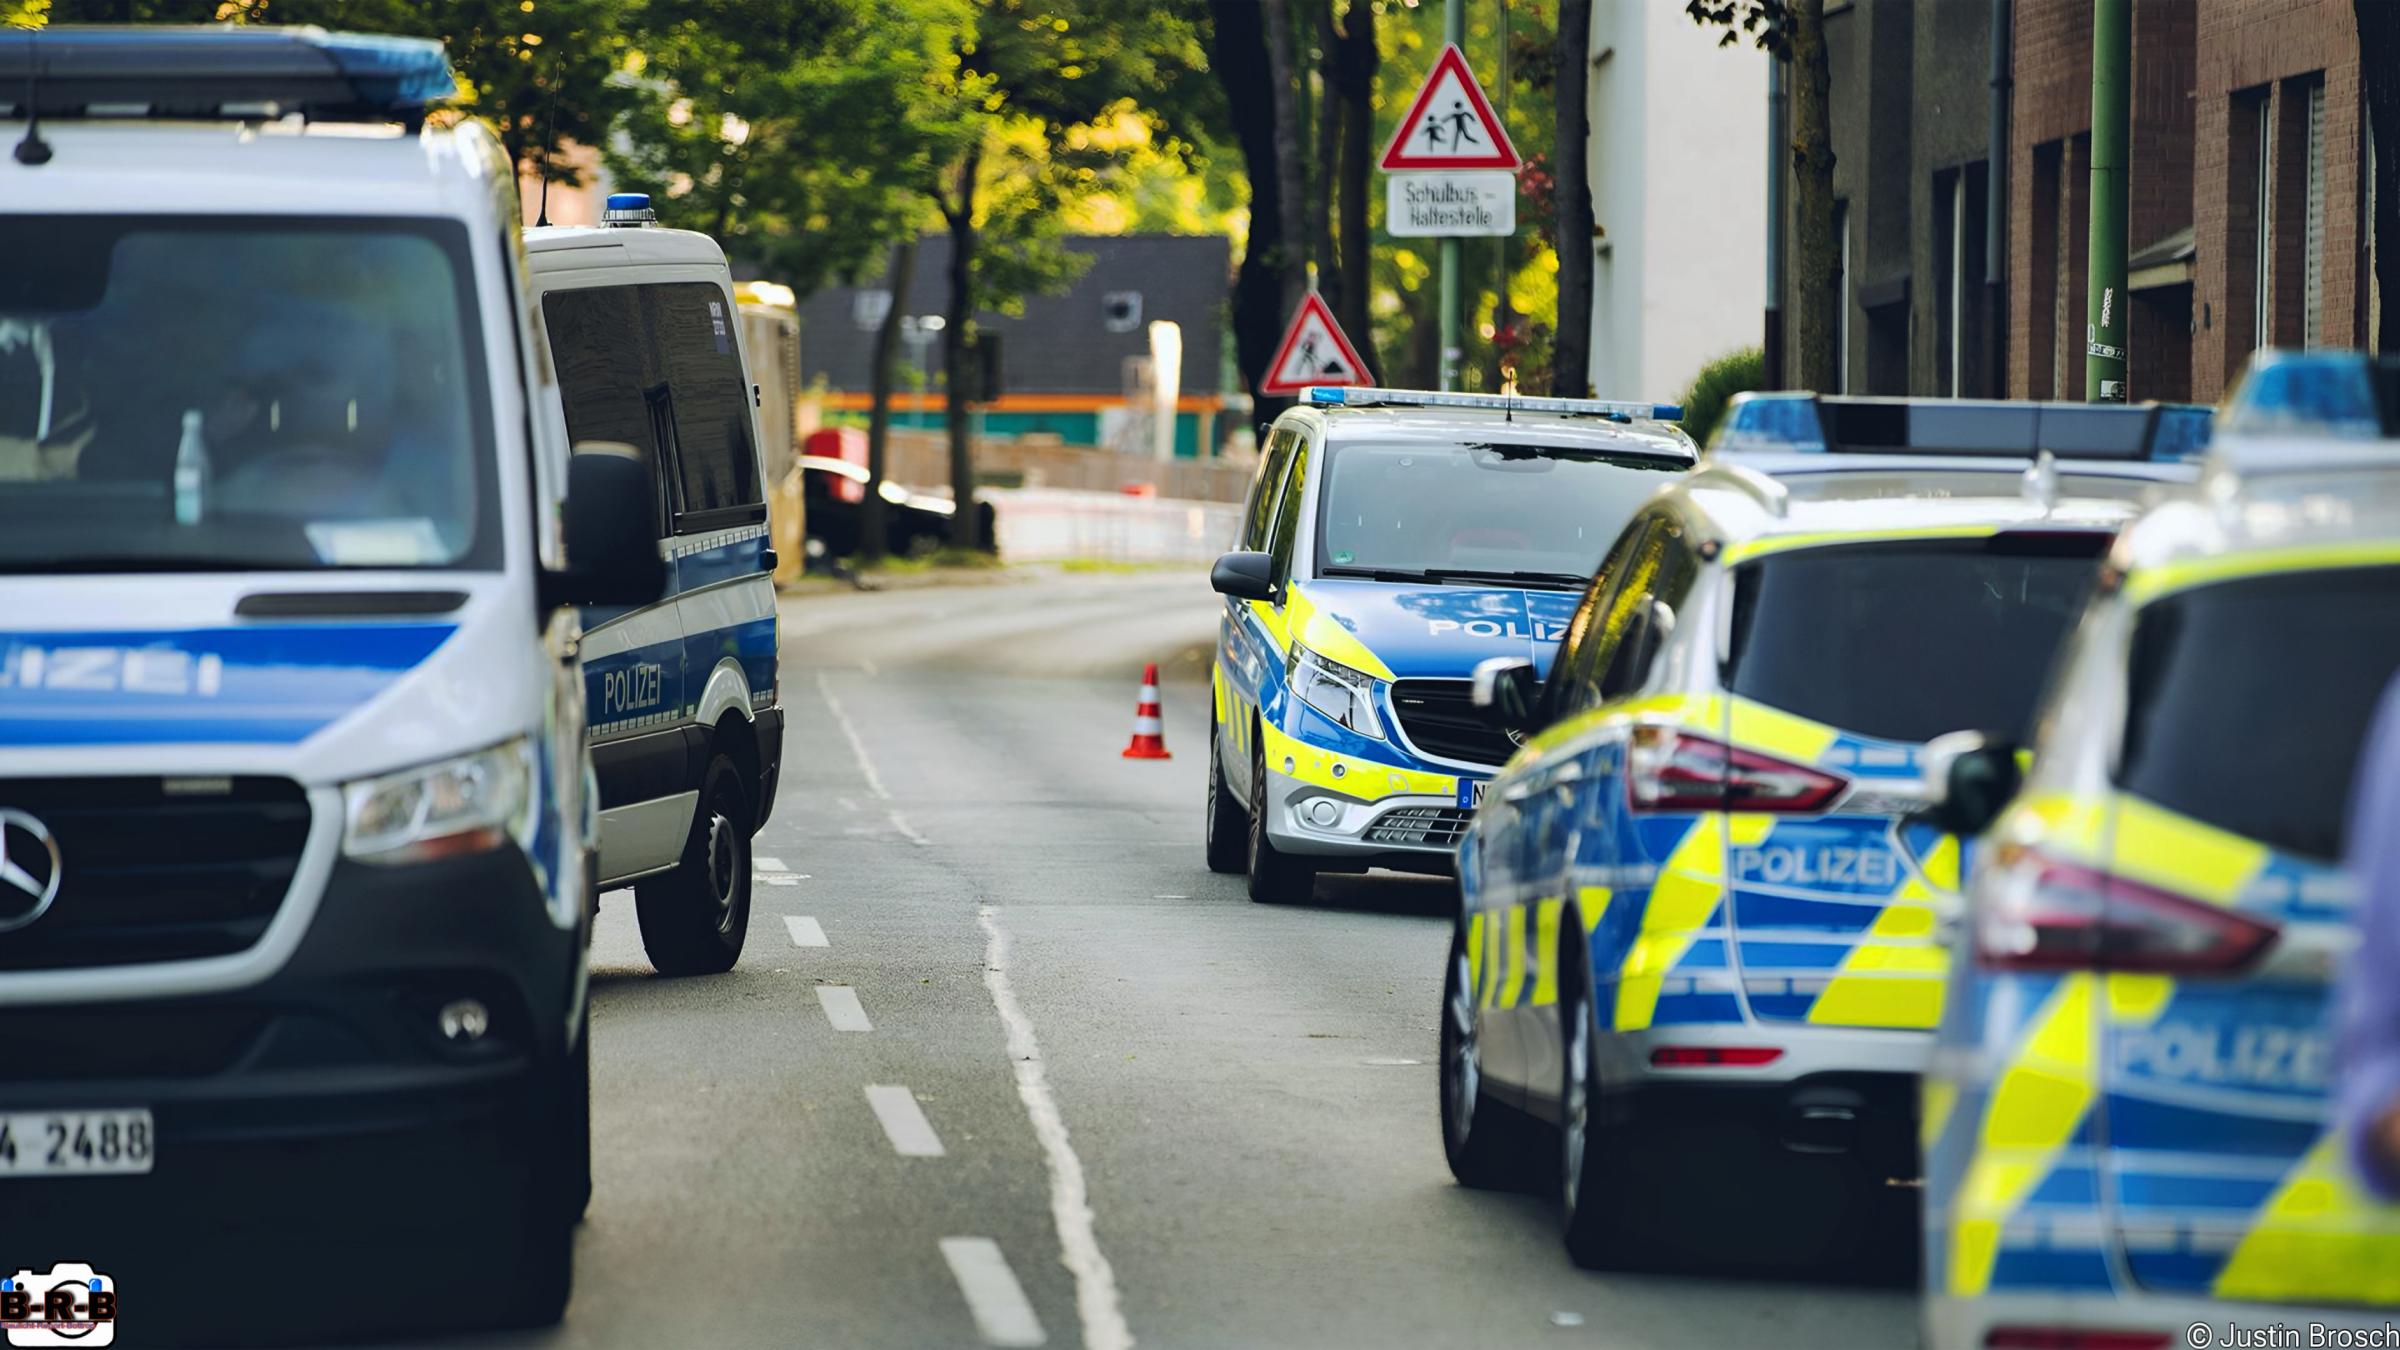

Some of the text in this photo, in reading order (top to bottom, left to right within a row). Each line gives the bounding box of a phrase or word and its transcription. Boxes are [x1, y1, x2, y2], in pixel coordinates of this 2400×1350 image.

[1410, 205, 1493, 227] Haltestelle
[604, 663, 661, 715] POLIZEI
[1737, 846, 1897, 885] POLIZEI
